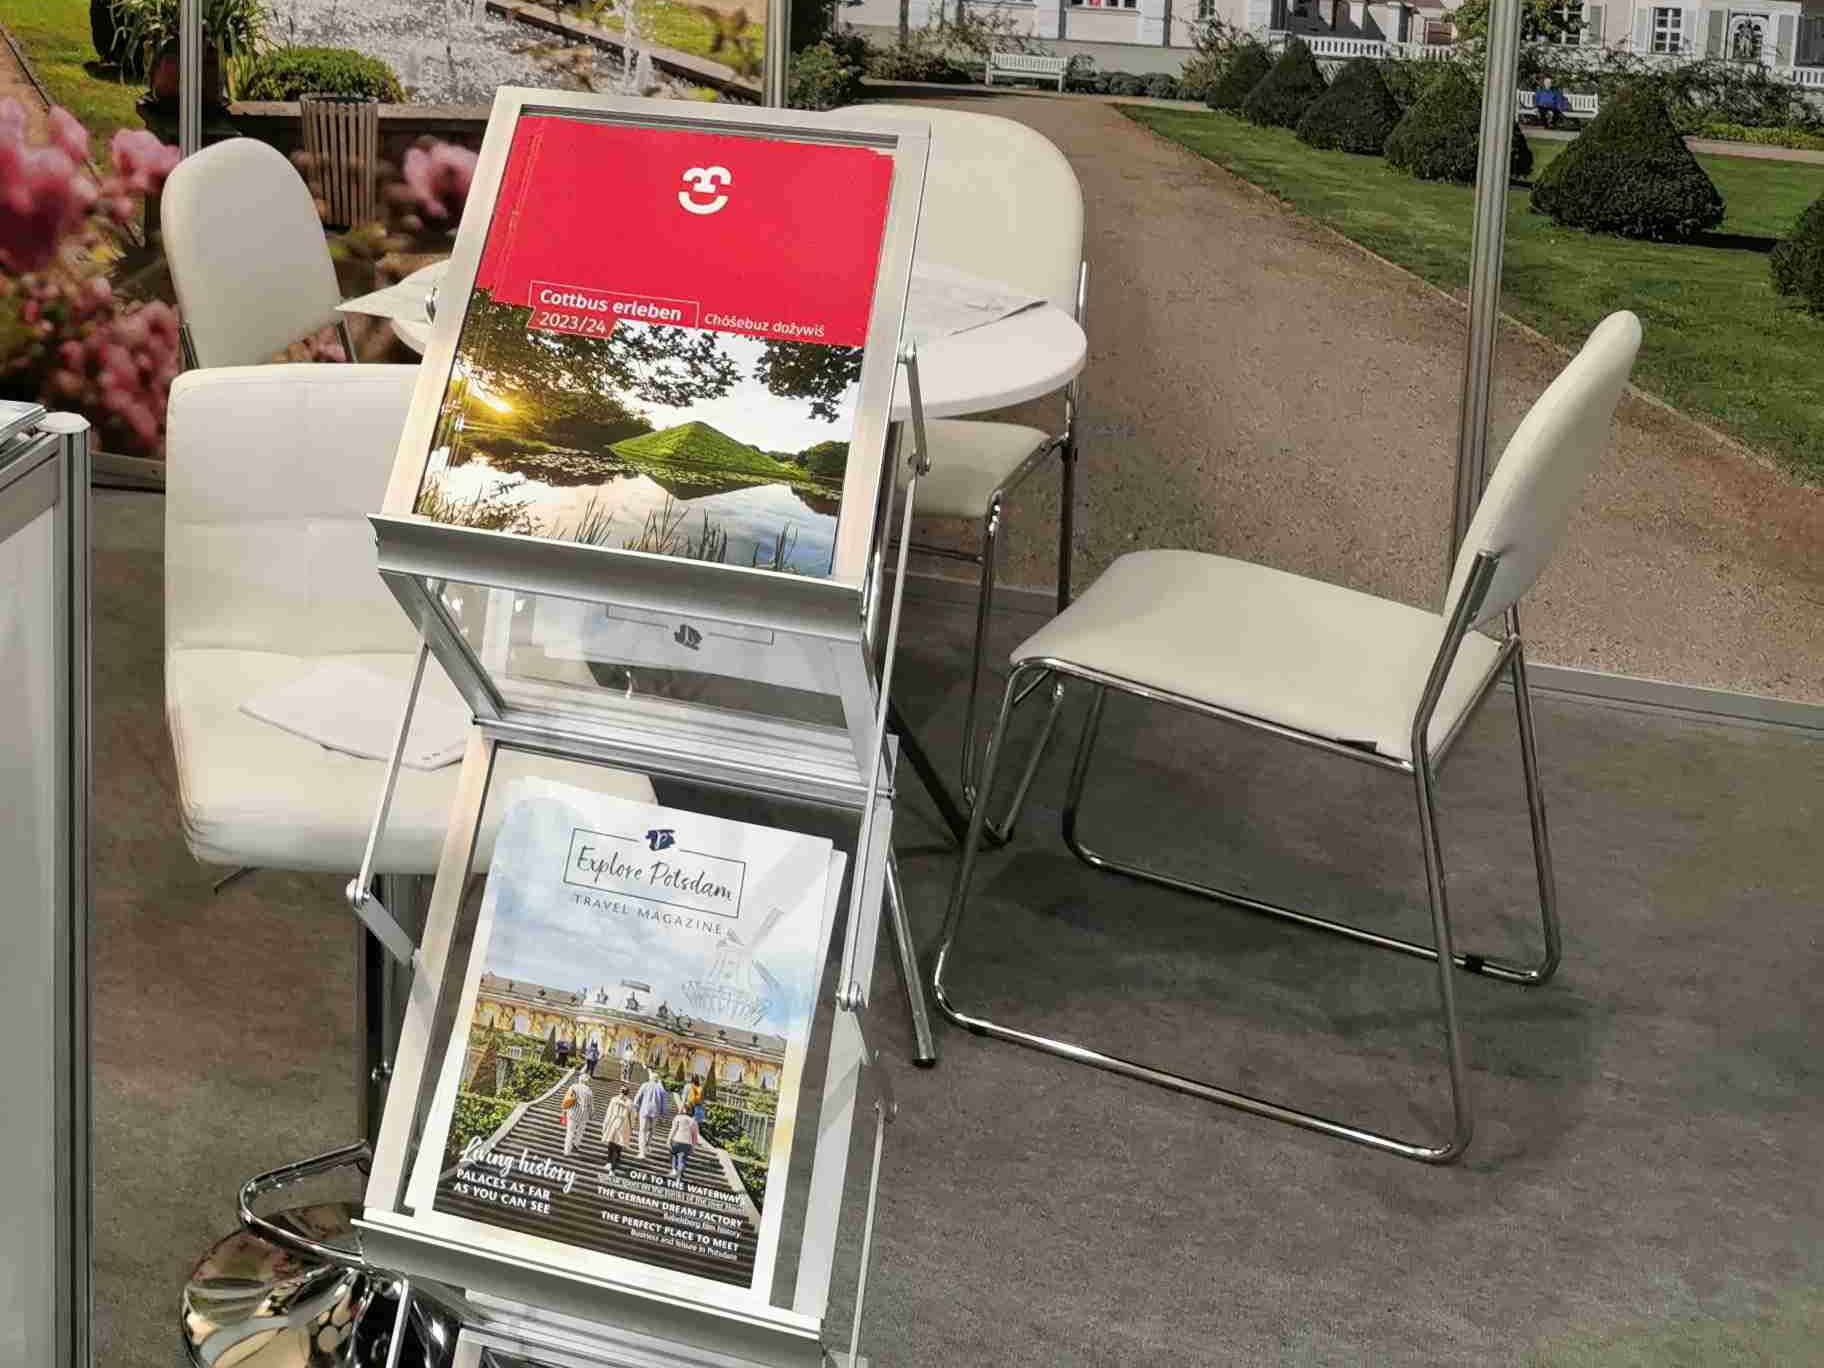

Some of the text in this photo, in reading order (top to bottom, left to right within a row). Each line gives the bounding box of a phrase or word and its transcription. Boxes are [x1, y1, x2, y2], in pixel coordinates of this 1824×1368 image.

[539, 311, 607, 334] 2023/24
[540, 288, 682, 321] Cottbus erleben
[576, 845, 733, 902] Explore Potsdam
[575, 894, 725, 936] TRAVEL MAGAZINE
[459, 1135, 578, 1193] Living history
[651, 1174, 664, 1185] TO
[454, 1183, 551, 1215] AS YOU CAN SEE
[456, 1168, 551, 1201] PALACES AS FAR
[597, 1186, 616, 1199] THE
[618, 1190, 660, 1209] GERMAN
[662, 1201, 697, 1217] DREAM
[699, 1209, 744, 1228] FACTORY
[601, 1210, 620, 1223] THE
[622, 1215, 662, 1233] PERFECT
[664, 1226, 694, 1242] PLACE
[696, 1234, 710, 1245] TO
[712, 1238, 739, 1252] MEET
